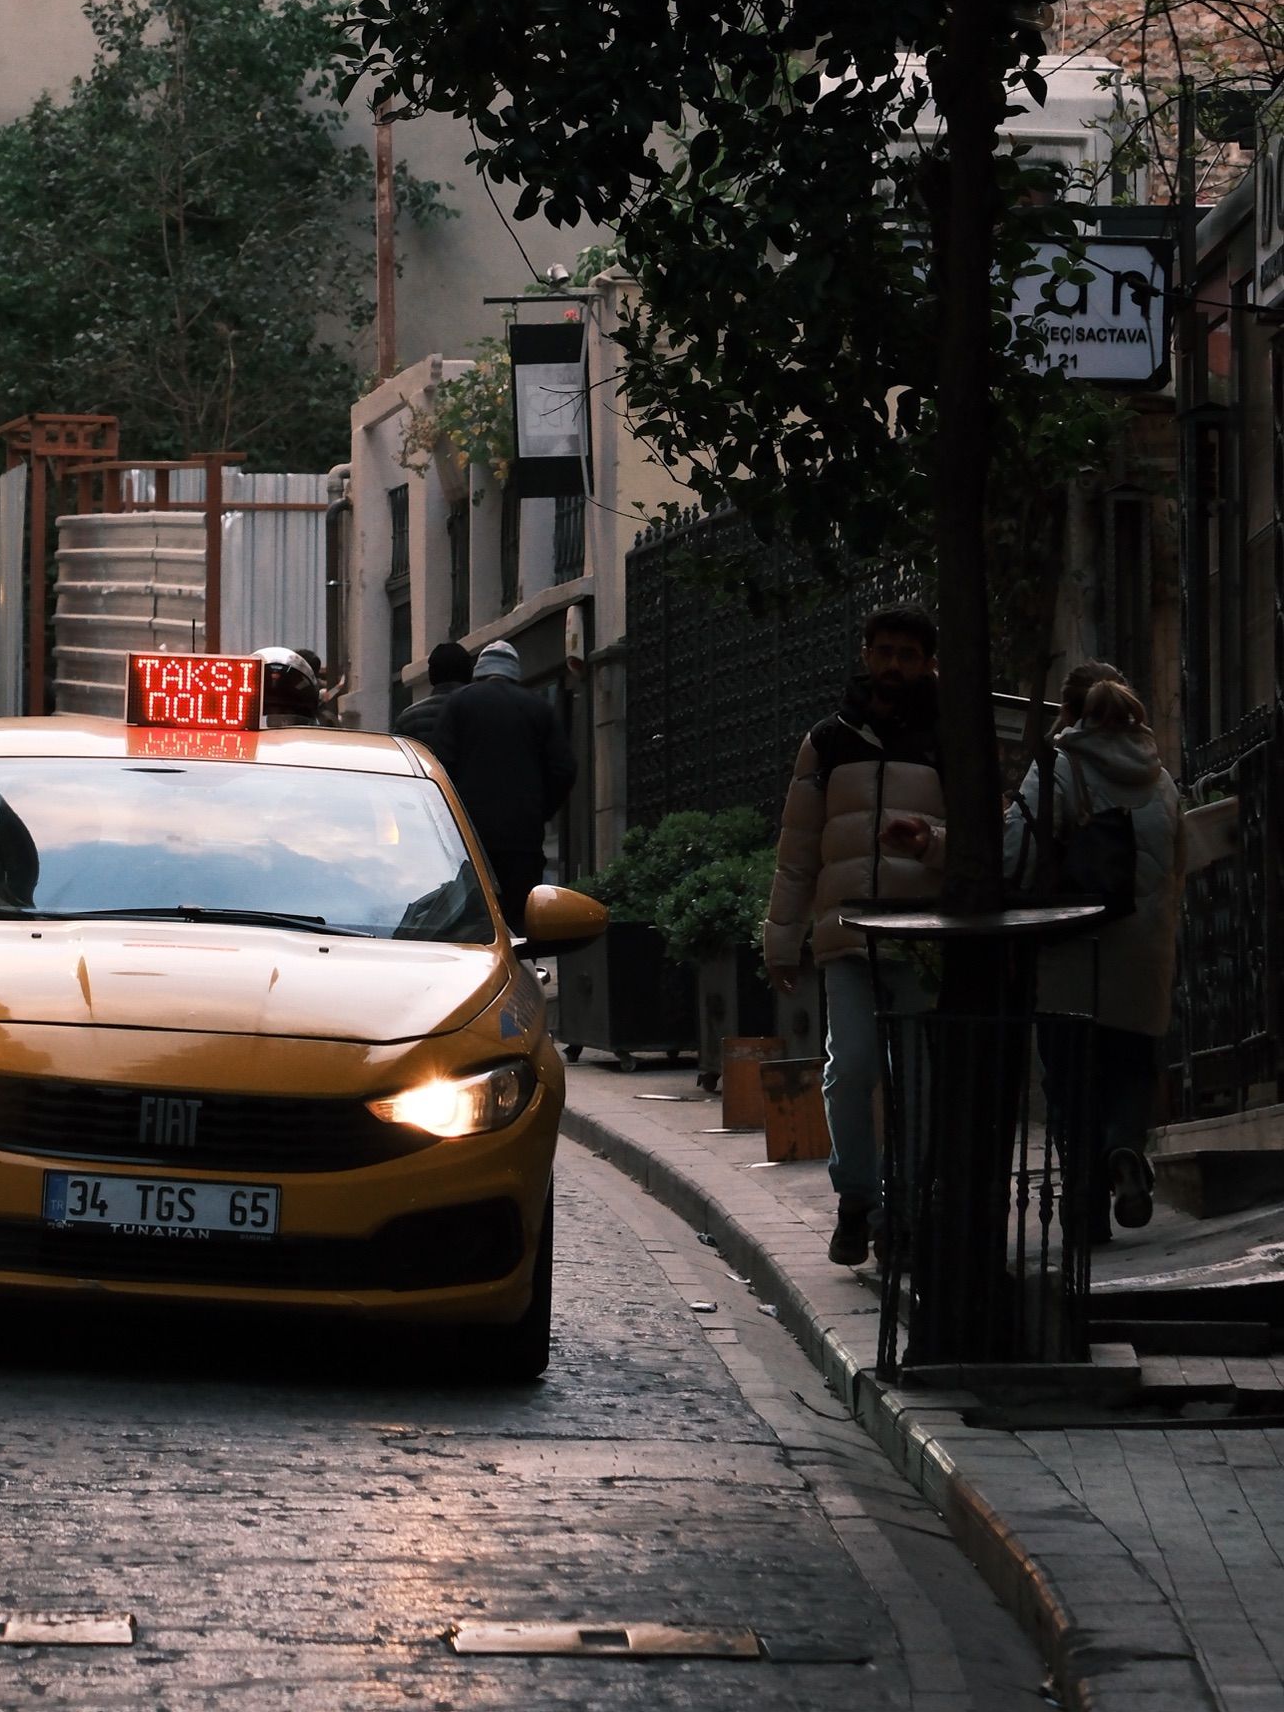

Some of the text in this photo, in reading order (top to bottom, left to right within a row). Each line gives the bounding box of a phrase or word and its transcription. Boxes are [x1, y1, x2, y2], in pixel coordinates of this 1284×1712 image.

[138, 659, 253, 693] TAKSI
[148, 692, 244, 725] DOLU
[139, 1095, 203, 1147] FIAT
[51, 1199, 64, 1211] TR
[69, 1180, 270, 1228] 34 TGS 65
[109, 1223, 211, 1240] TUNAHAN
